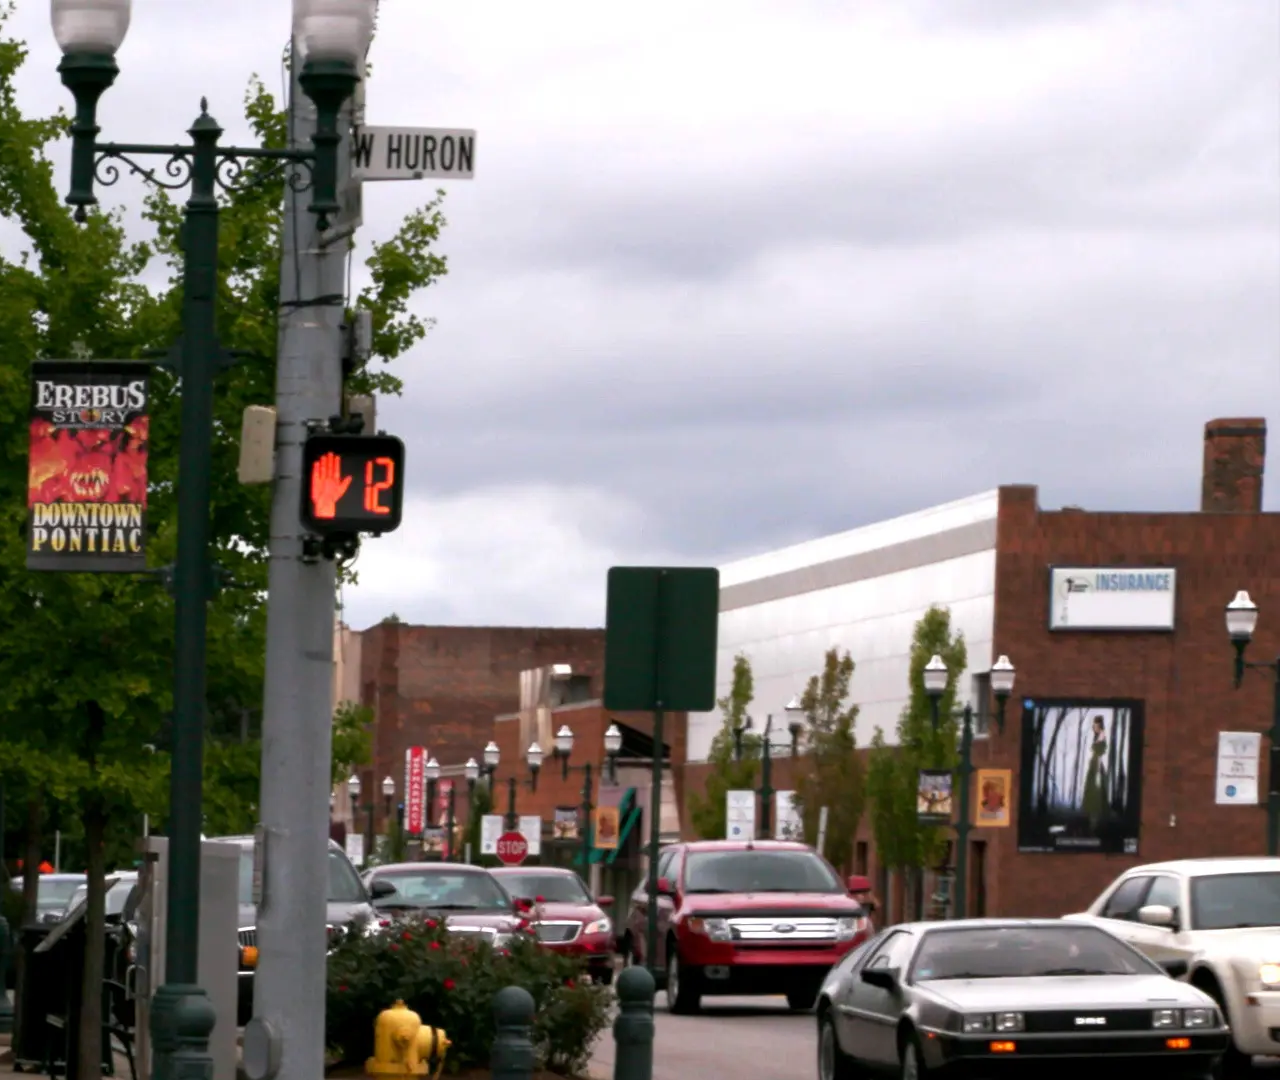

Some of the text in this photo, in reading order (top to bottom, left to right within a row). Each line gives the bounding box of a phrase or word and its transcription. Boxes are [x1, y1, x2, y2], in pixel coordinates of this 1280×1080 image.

[354, 133, 474, 172] W HURON
[36, 379, 145, 410] EREBUS
[52, 410, 129, 424] STORY
[33, 502, 142, 527] DOWNTOWN
[32, 527, 142, 552] PONTIAC
[1095, 573, 1170, 591] INSURANCE
[498, 840, 528, 854] STOP
